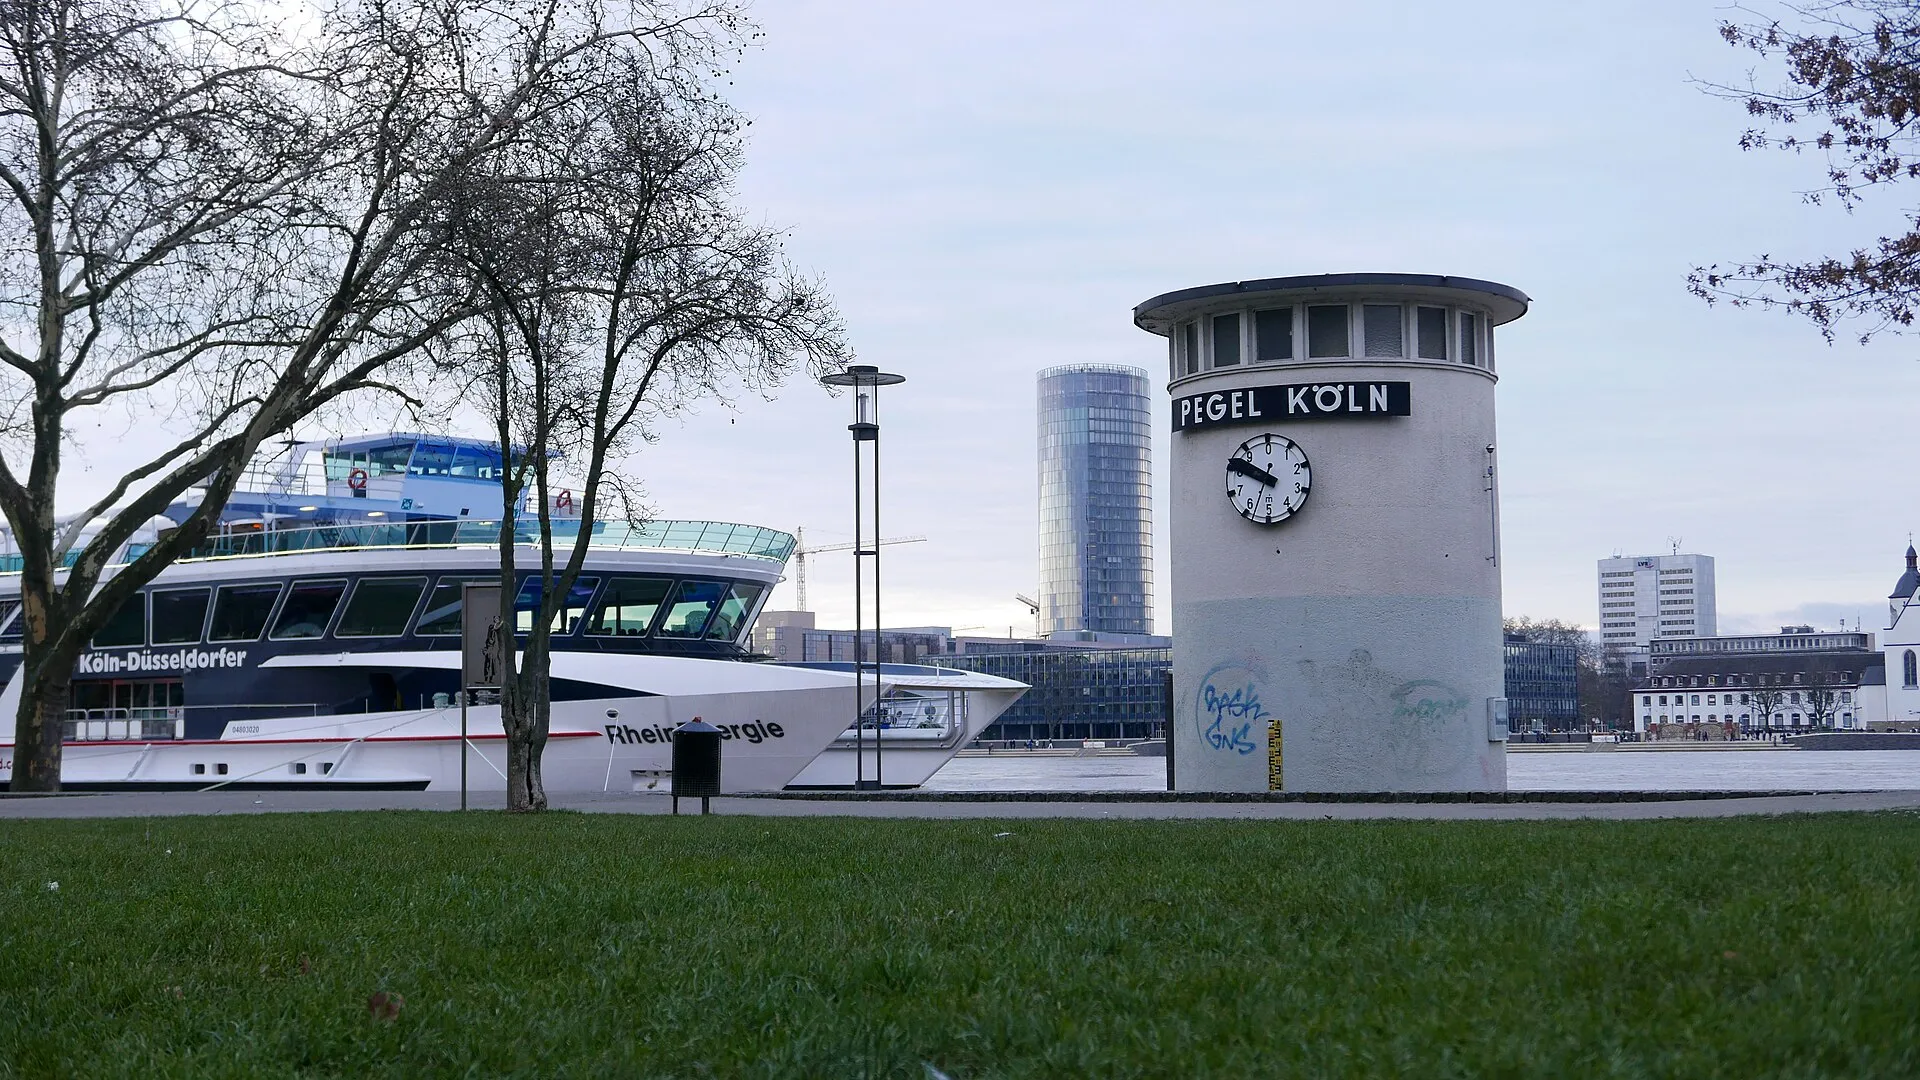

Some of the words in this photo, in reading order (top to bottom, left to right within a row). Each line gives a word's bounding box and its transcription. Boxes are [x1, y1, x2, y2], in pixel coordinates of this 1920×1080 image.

[1181, 390, 1262, 427] PEGEL
[1288, 384, 1388, 414] KÖLN
[1265, 443, 1272, 455] 0
[1284, 448, 1289, 460] 1
[1246, 451, 1253, 462] 9
[1293, 463, 1301, 475] 2
[1237, 485, 1244, 496] 7
[1294, 482, 1301, 494] 3
[1246, 498, 1253, 510] 6
[1283, 496, 1291, 507] 4
[1266, 504, 1272, 515] 5
[79, 647, 248, 674] Köln-Düsseldorfer
[605, 720, 785, 745] Rheinergie
